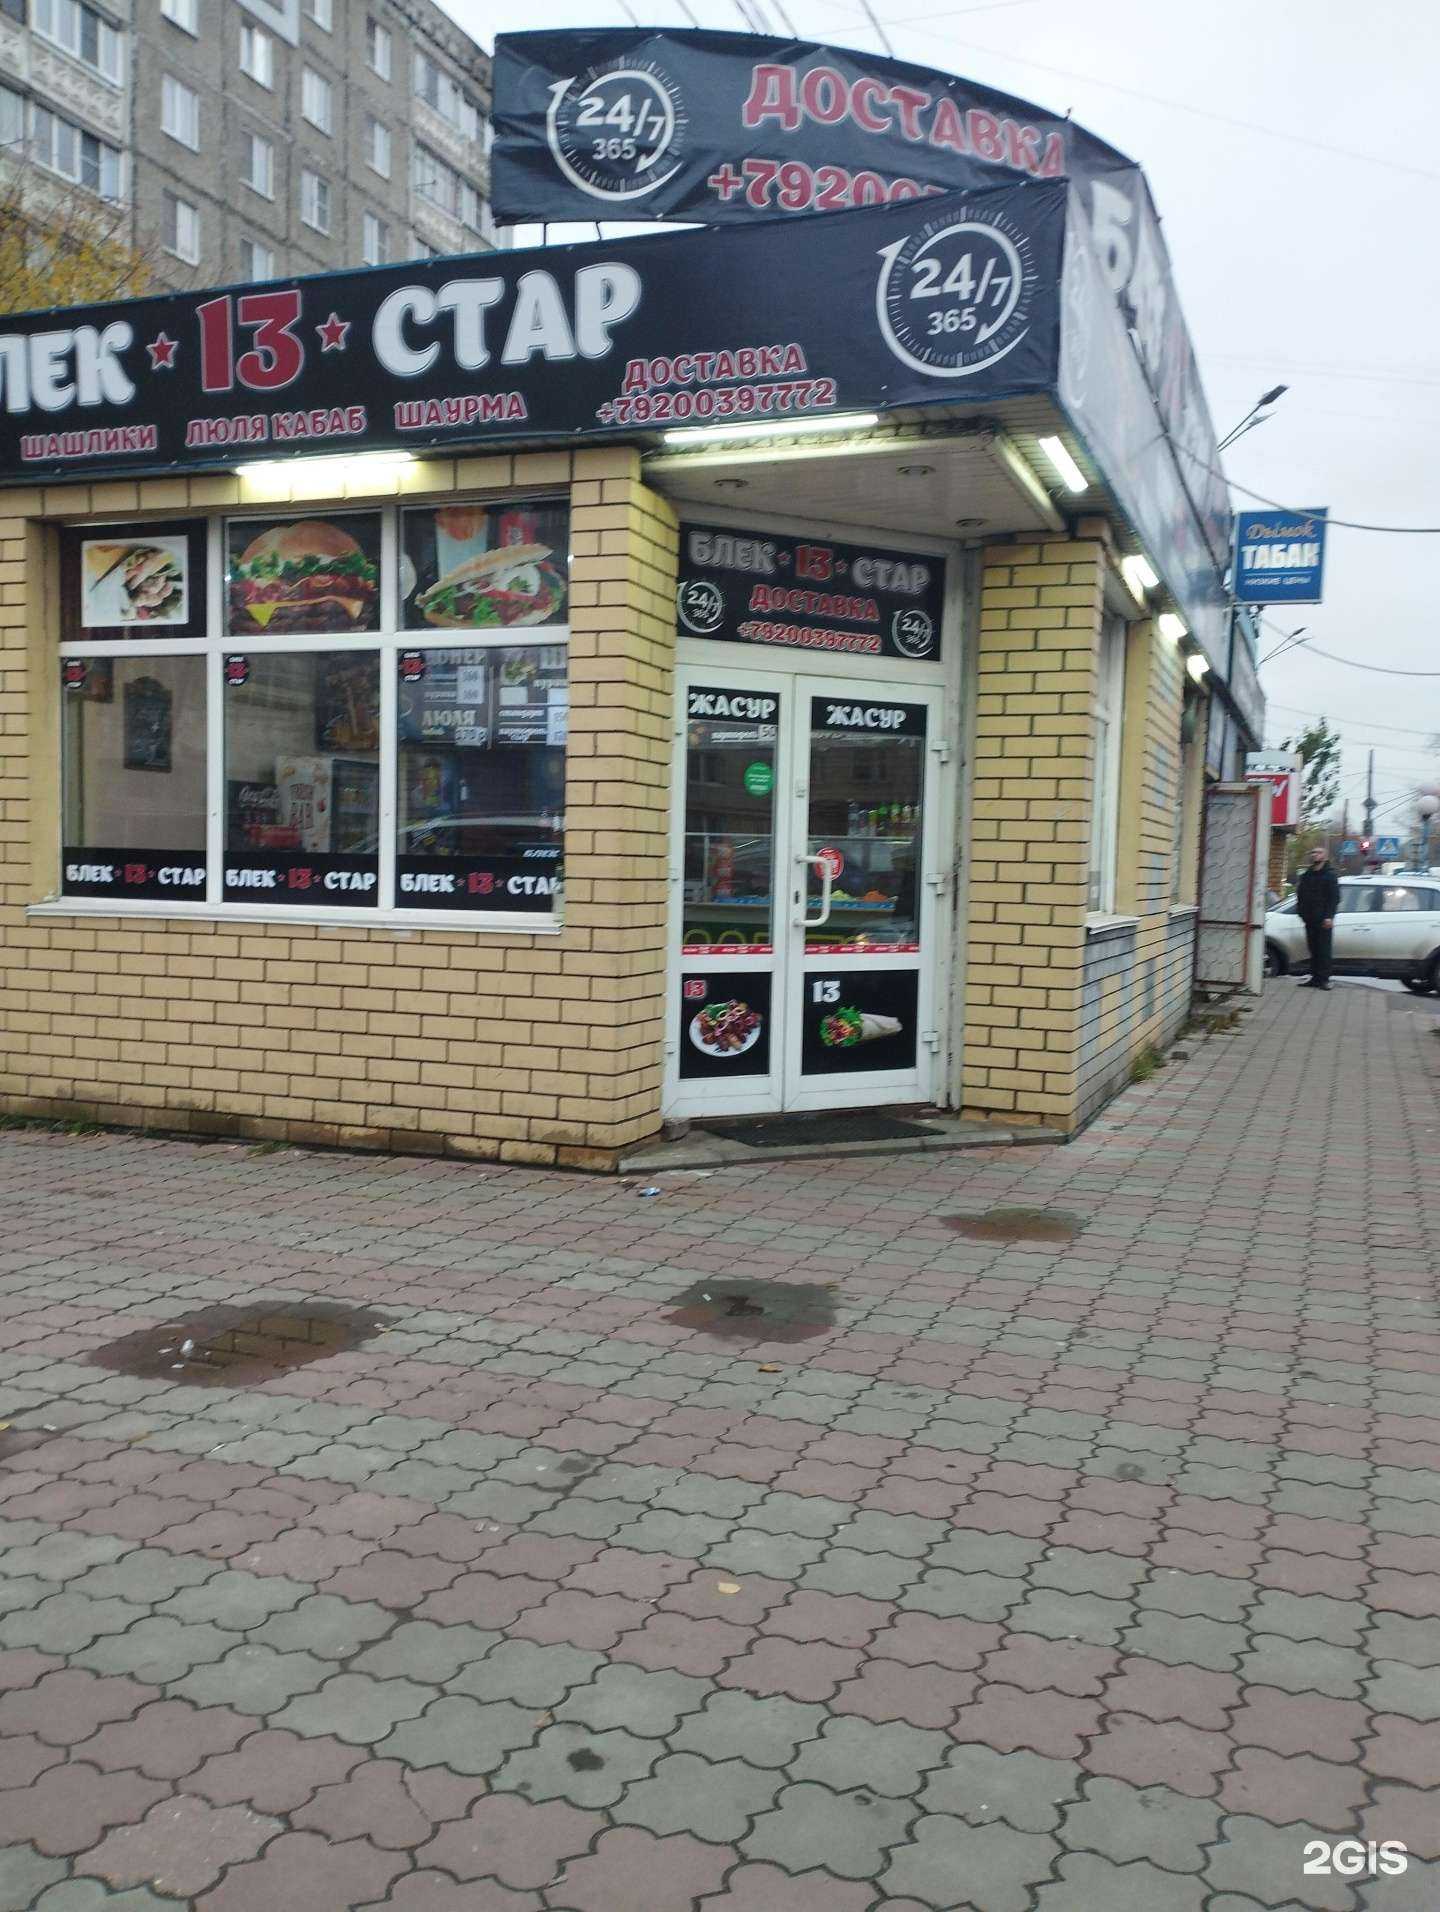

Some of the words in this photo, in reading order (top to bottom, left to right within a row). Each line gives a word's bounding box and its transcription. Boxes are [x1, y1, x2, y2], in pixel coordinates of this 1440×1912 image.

[576, 94, 666, 141] 24/7
[741, 64, 1065, 179] ДОСТАВКА
[592, 137, 637, 160] 365
[910, 253, 1011, 308] 24/7
[195, 289, 303, 394] 13
[372, 262, 642, 378] СТАР
[927, 307, 978, 336] 365
[621, 343, 808, 395] ДОСТАВКА
[393, 391, 528, 429] ШАУРМА
[595, 378, 837, 424] +79200397772
[20, 424, 158, 461] ШАШЛИКИ
[185, 414, 269, 447] ЛЮЛЯ
[271, 405, 368, 440] КАБАБ
[689, 530, 777, 574] БЛЕК
[796, 544, 833, 581] 13
[852, 556, 930, 595] СТАР
[1241, 543, 1320, 570] ТАБАК
[748, 583, 880, 621] ДОСТАВКА
[688, 692, 777, 719] ЖАСУР
[826, 704, 906, 729] ЖАСУР
[65, 864, 114, 883] БЛЕК
[124, 864, 147, 884] 13
[157, 867, 206, 885] СТАР
[226, 869, 277, 888] БЛЕК
[288, 868, 312, 889] 13
[324, 871, 377, 891] СТАР
[400, 873, 455, 893] БЛЕК
[468, 873, 494, 895] 13
[812, 980, 841, 1003] 13
